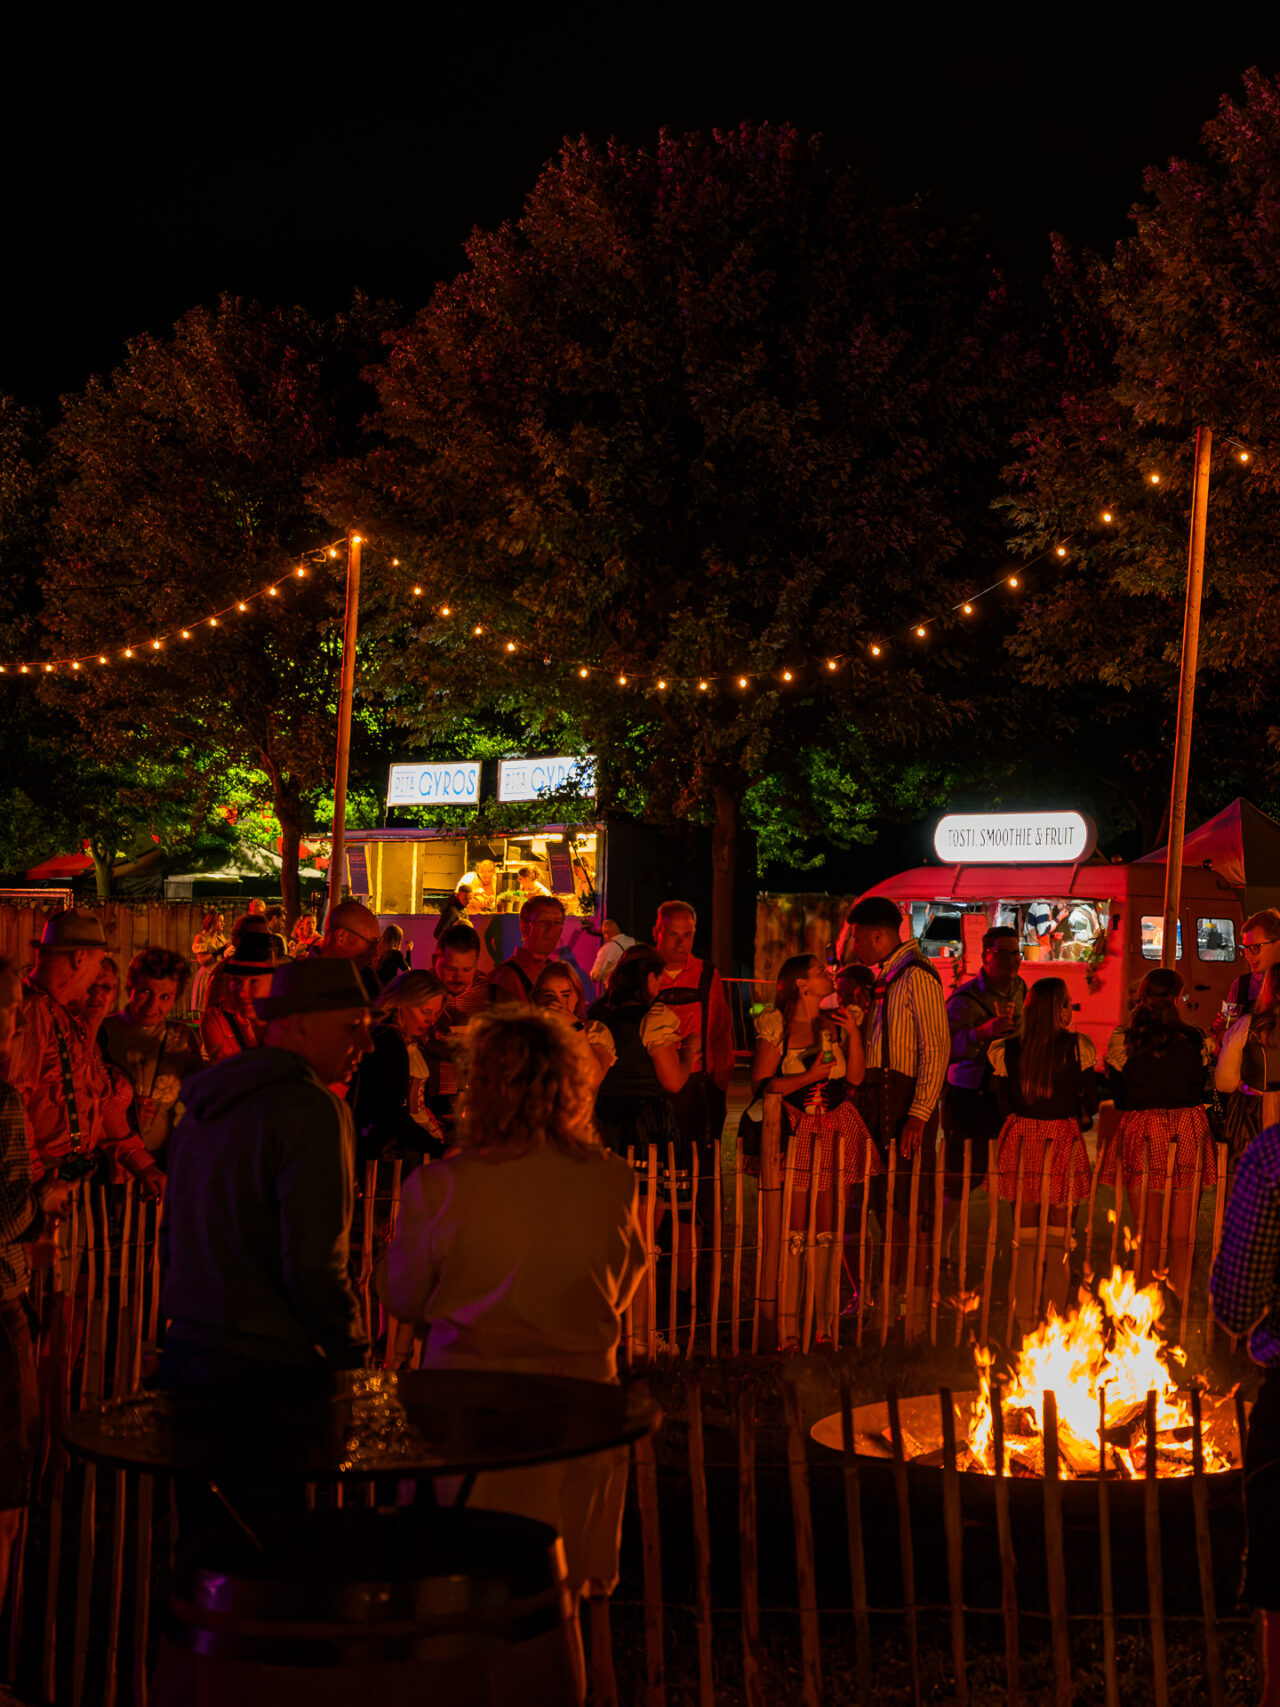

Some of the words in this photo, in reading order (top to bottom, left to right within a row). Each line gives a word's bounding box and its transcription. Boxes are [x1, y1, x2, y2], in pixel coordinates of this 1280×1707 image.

[419, 769, 476, 796] GYROS
[980, 828, 1032, 847] SMOOTHIE
[1036, 828, 1042, 845] &
[1045, 827, 1075, 845] FRUIT
